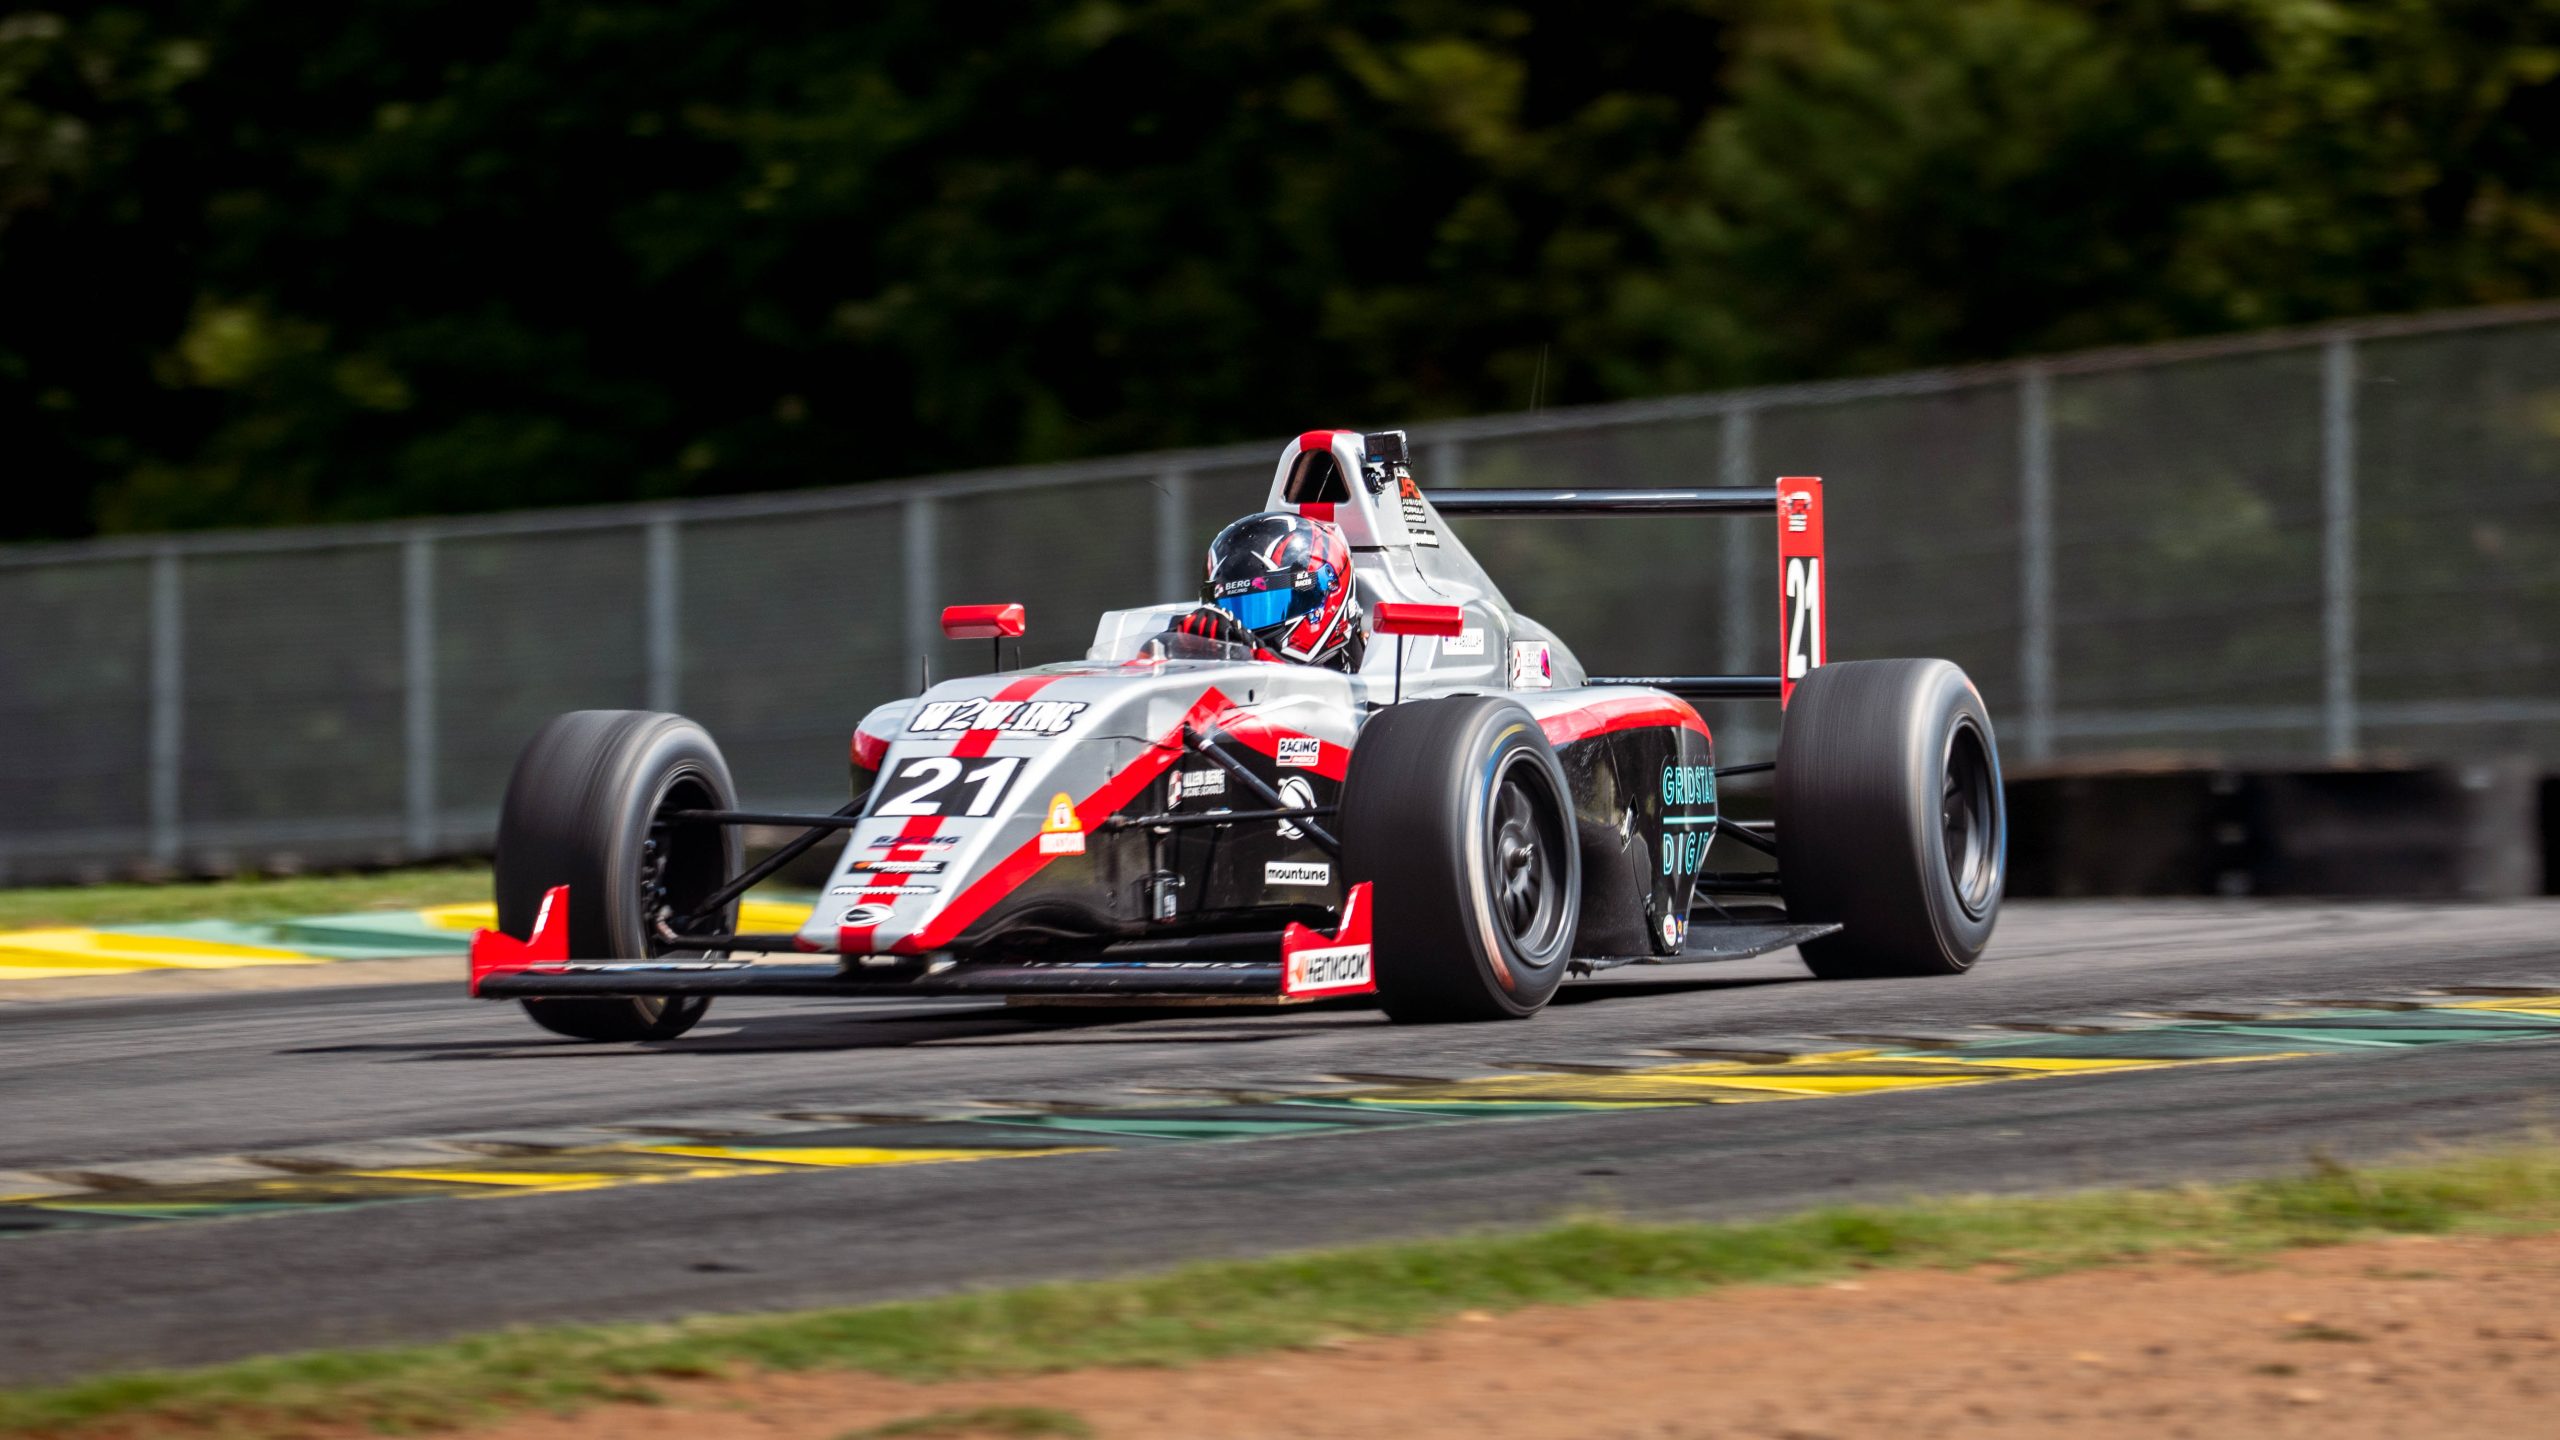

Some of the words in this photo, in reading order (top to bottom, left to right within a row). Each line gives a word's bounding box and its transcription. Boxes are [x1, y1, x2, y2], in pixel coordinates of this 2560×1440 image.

[1225, 579, 1251, 591] BERG
[1786, 558, 1820, 679] 21
[1280, 740, 1318, 753] RACING
[874, 756, 1021, 817] 21
[873, 836, 962, 844] RACING
[1267, 867, 1326, 881] mountune
